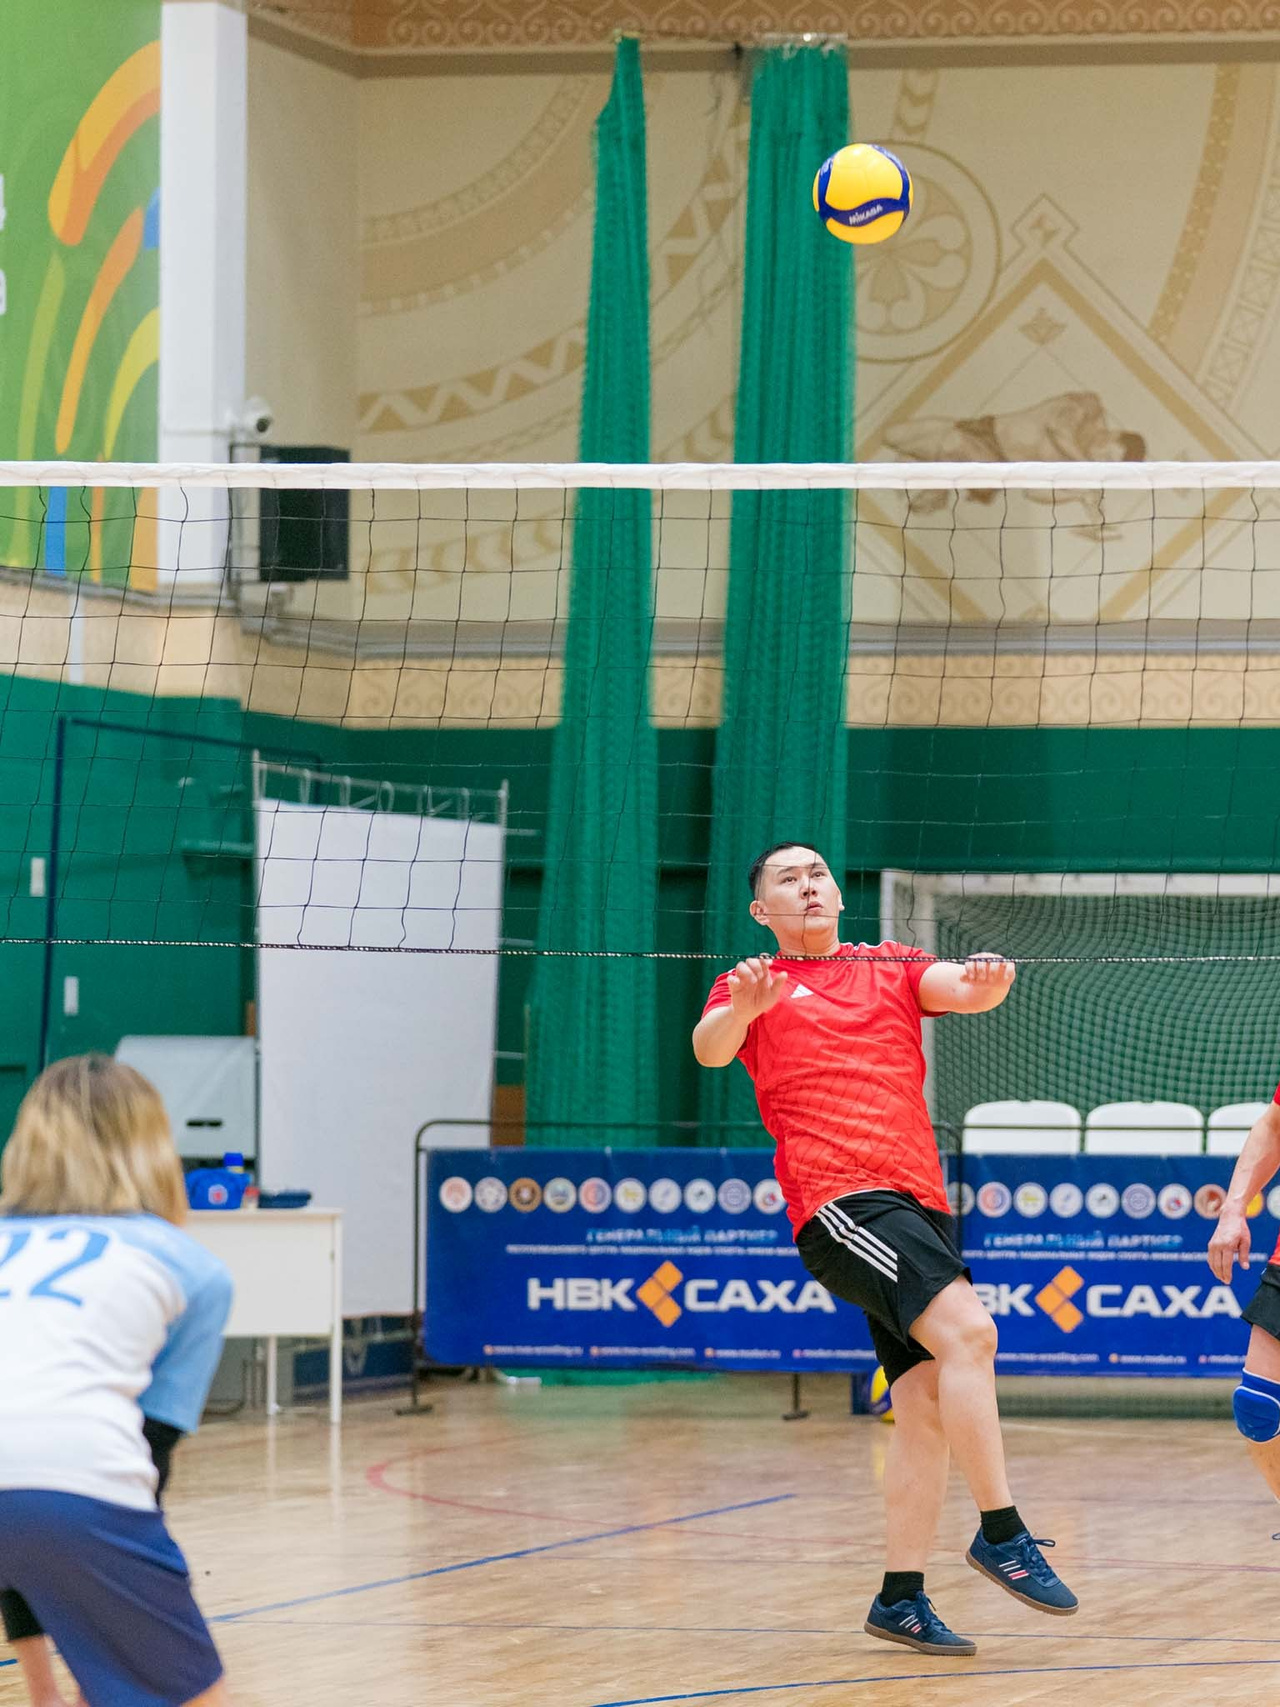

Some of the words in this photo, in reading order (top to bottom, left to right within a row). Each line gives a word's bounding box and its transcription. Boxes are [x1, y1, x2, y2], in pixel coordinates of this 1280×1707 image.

[527, 1278, 637, 1311] НВК
[684, 1279, 837, 1313] САХА
[972, 1283, 1036, 1316] ВК
[1086, 1284, 1243, 1318] САХА
